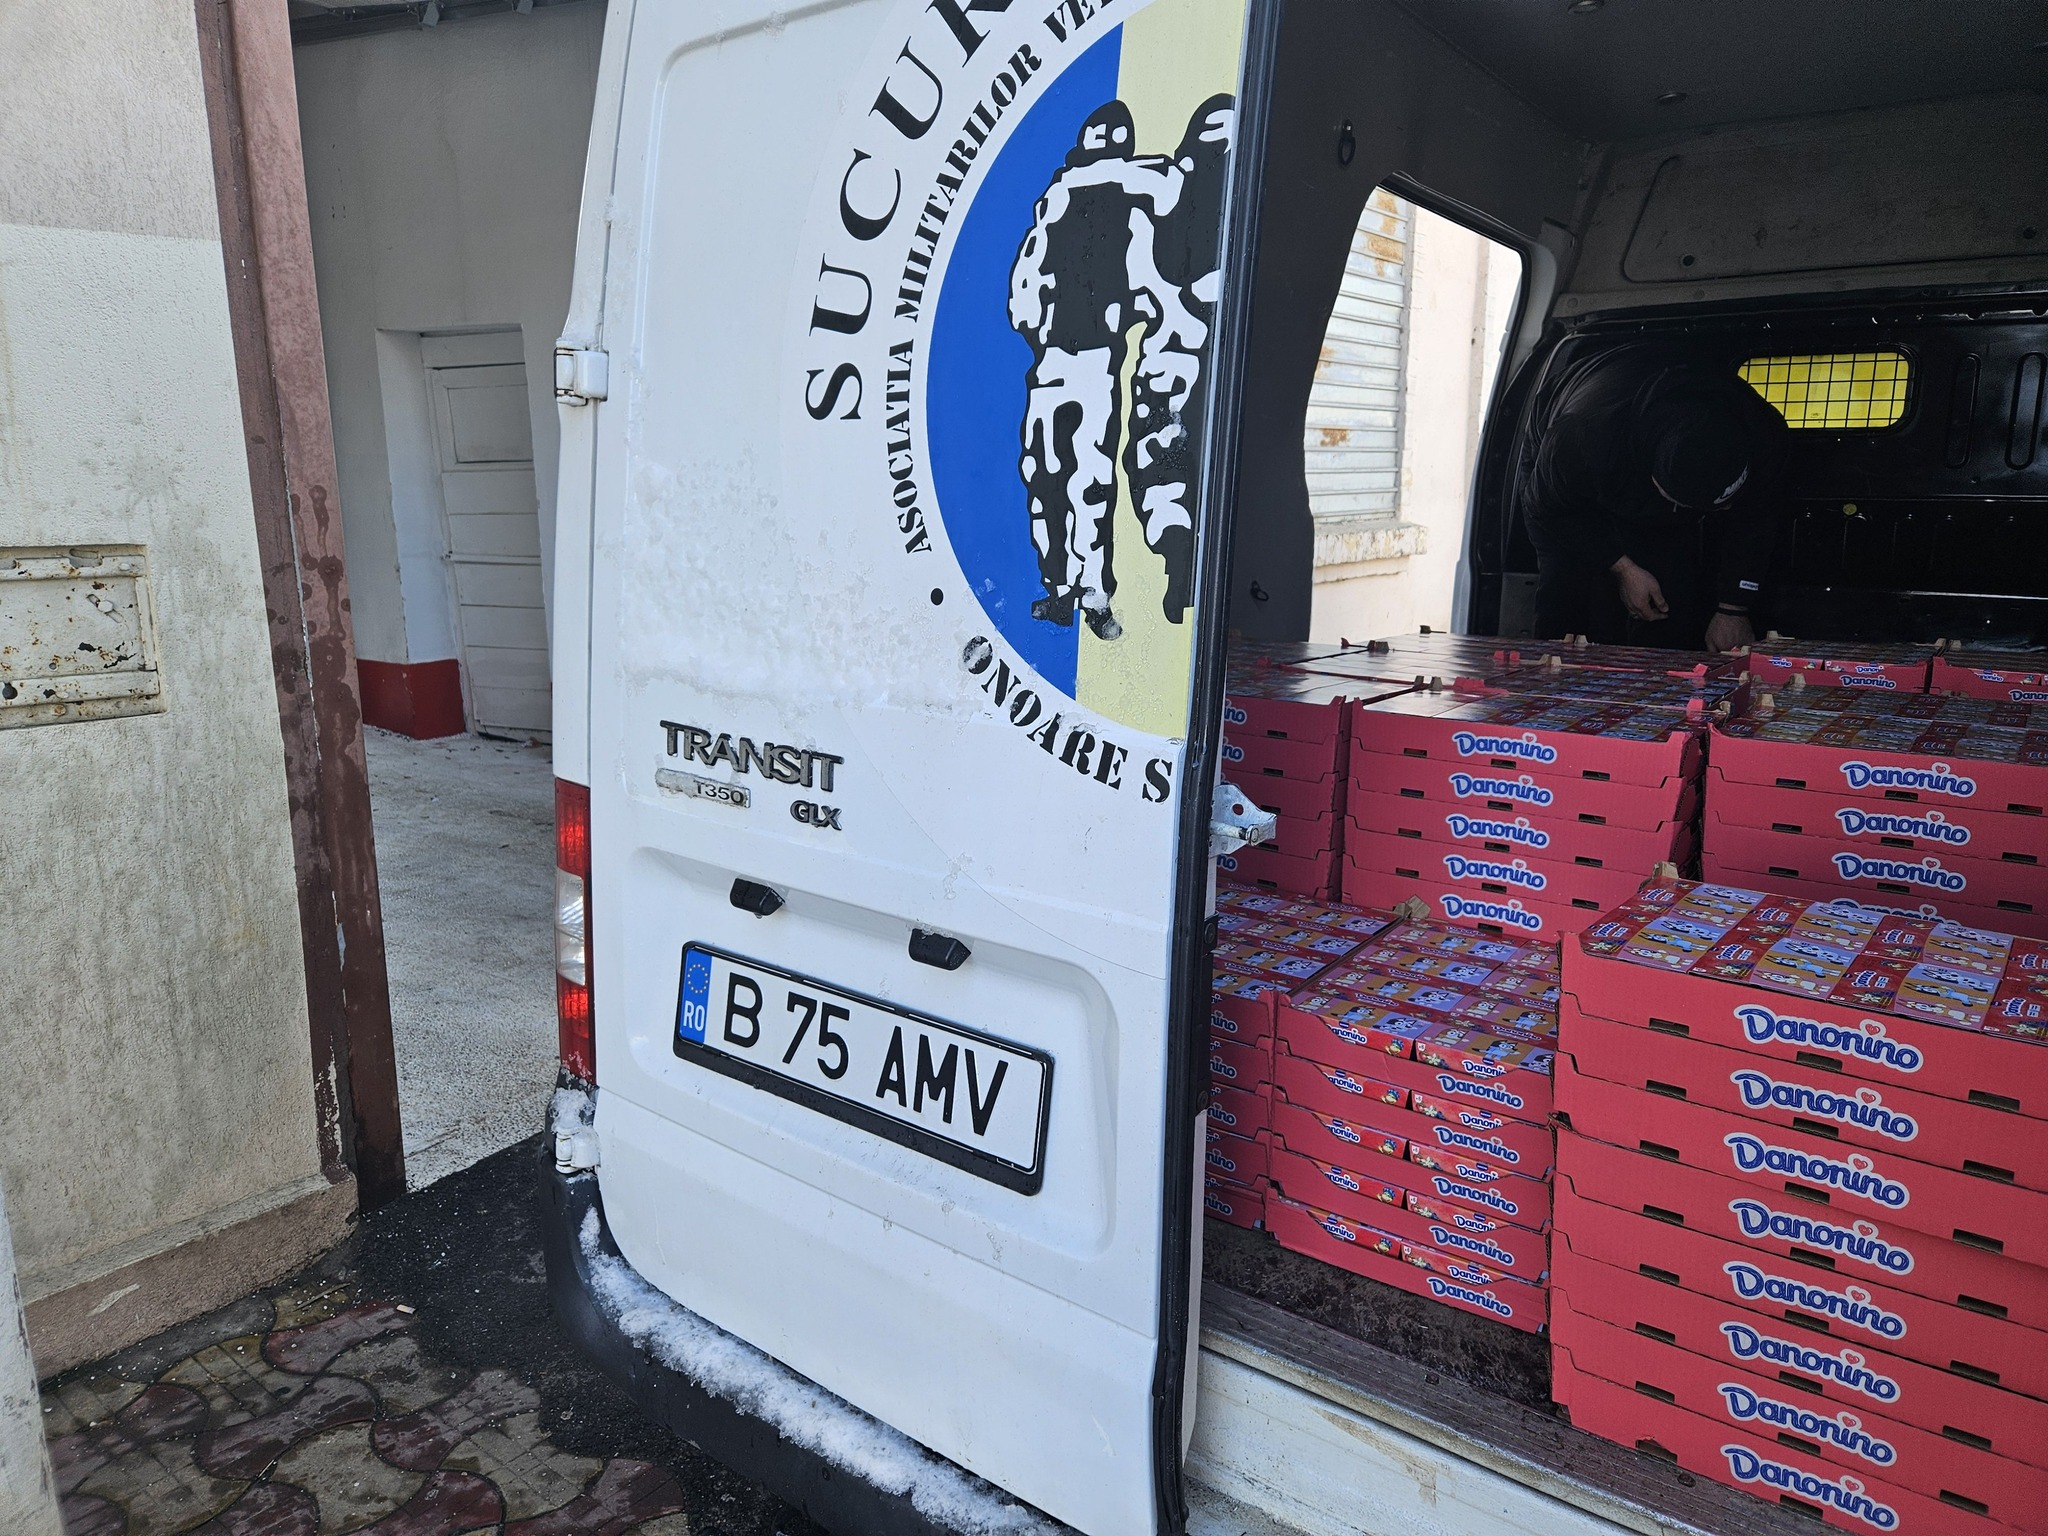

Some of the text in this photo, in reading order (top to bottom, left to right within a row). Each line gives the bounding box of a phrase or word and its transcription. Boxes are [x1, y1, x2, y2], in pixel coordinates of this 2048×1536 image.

[886, 0, 1113, 554] ASOCIATIA MILITARILOR VE
[1841, 675, 1895, 689] Danonino
[962, 635, 1128, 789] ONOARE
[660, 720, 844, 792] TRANSIT
[1454, 734, 1554, 761] Danonino
[693, 780, 745, 804] T350
[1451, 775, 1551, 803] Danonino
[1843, 764, 1973, 795] Danonino
[790, 800, 842, 831] GLX
[1448, 816, 1547, 846] Danonino
[1838, 810, 1968, 843] Danonino
[1446, 857, 1544, 888] Danonino
[1835, 855, 1965, 890] Danonino
[1442, 896, 1539, 931] Danonino
[683, 1000, 705, 1032] RO
[724, 972, 1009, 1137] B 75 AMV
[1738, 1008, 1919, 1068] Danonino
[1463, 1061, 1505, 1076] Danoni
[1438, 1075, 1521, 1107] Danonino
[1735, 1073, 1913, 1138] Danonino
[1208, 1106, 1235, 1124] nino
[1460, 1113, 1502, 1128] Danoni
[1435, 1127, 1518, 1161] Danonino
[1206, 1152, 1234, 1170] nino
[1457, 1165, 1499, 1181] Danoni
[1728, 1136, 1905, 1205] Danonino
[1433, 1178, 1516, 1213] Danonino
[1454, 1216, 1496, 1231] Danoni
[1733, 1203, 1910, 1270] Danonino
[1431, 1228, 1512, 1264] Danonino
[1449, 1266, 1491, 1284] Danoni
[1428, 1278, 1510, 1315] Danonino
[1728, 1266, 1902, 1335] Danonino
[1724, 1327, 1896, 1399] Danonino
[1722, 1388, 1892, 1462] Danonino
[1724, 1449, 1895, 1527] Danonino
